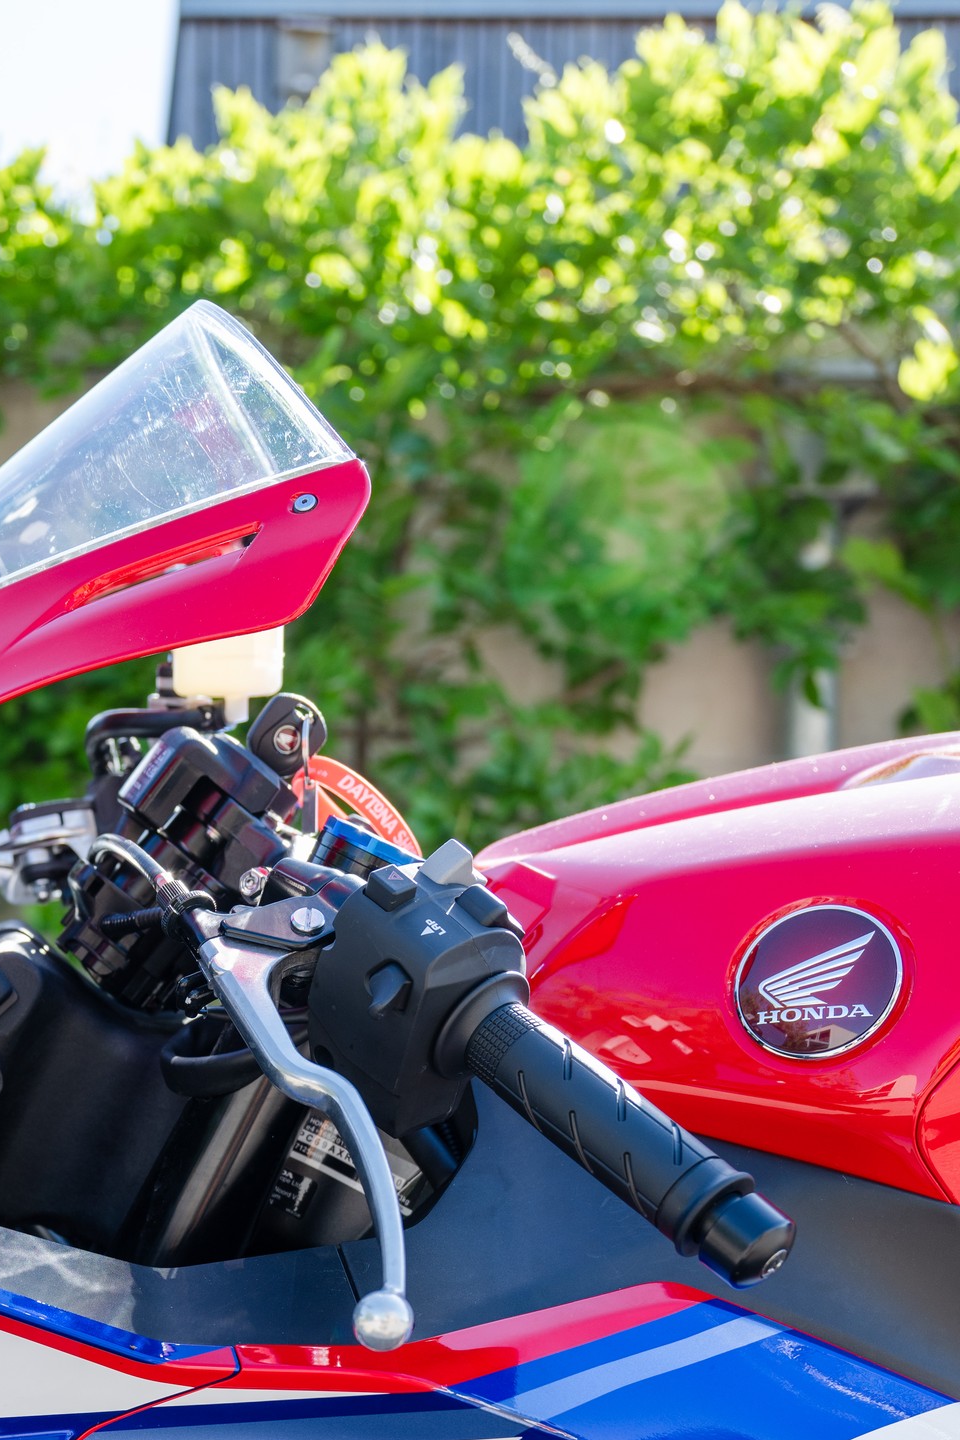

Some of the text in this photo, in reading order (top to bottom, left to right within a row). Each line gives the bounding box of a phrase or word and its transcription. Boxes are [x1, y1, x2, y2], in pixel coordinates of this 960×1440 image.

[337, 774, 399, 835] DAYTONA
[425, 919, 447, 936] LAP
[756, 1004, 874, 1026] HONDA
